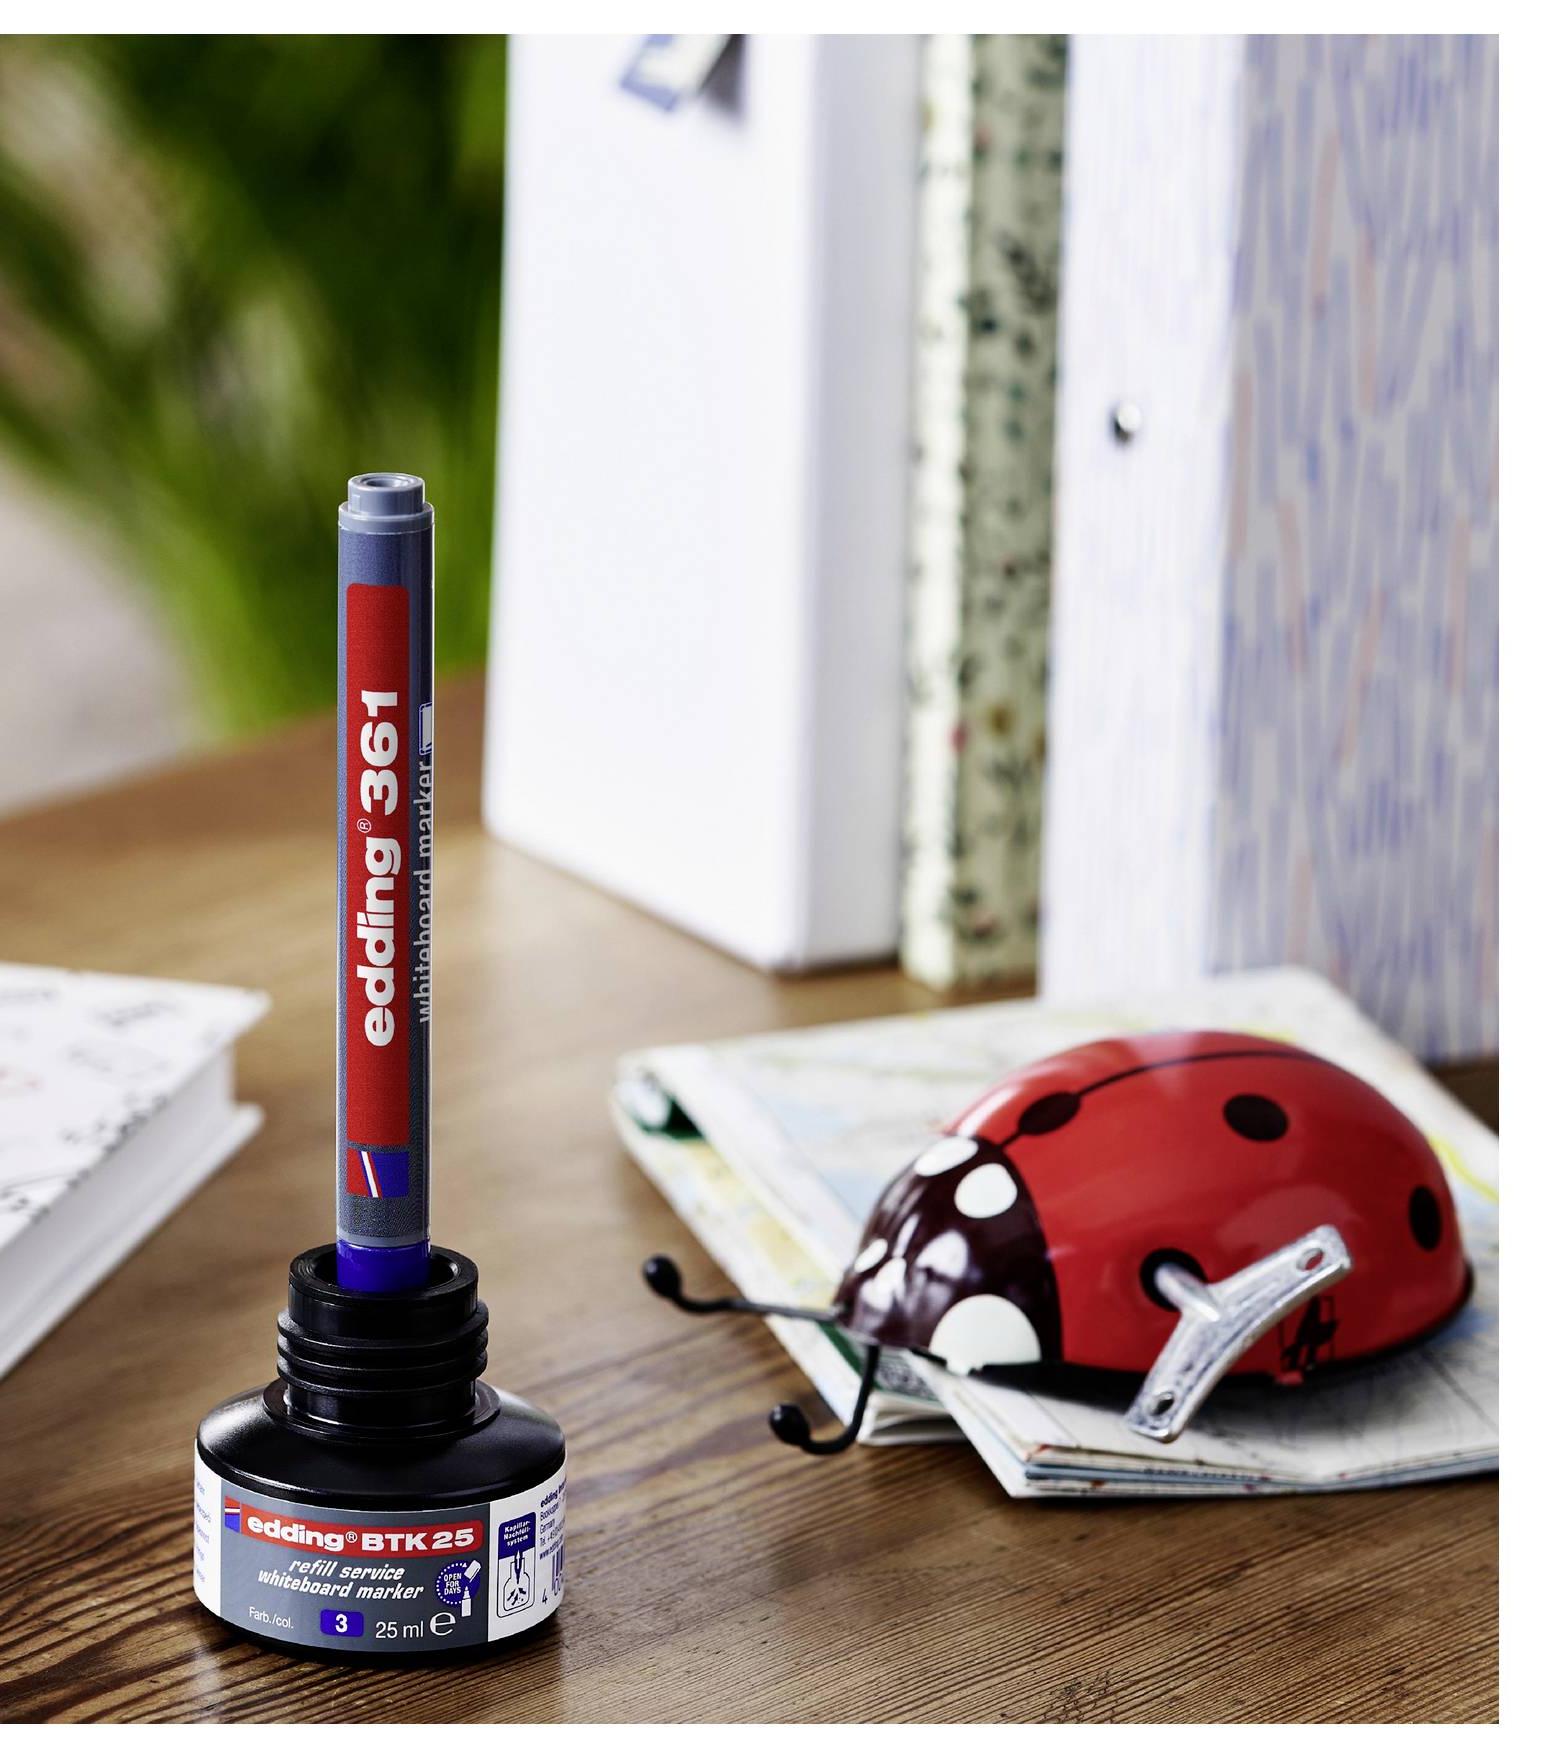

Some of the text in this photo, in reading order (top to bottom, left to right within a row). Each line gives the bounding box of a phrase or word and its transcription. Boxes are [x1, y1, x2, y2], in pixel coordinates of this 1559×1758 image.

[360, 689, 399, 816] 361
[413, 761, 433, 1023] whiteboard marker
[361, 1532, 428, 1552] BTK
[431, 1528, 475, 1550] 25
[506, 1534, 529, 1547] system
[288, 1559, 406, 1580] refill service
[443, 1572, 462, 1582] OPEN
[257, 1569, 424, 1600] whiteboard marker
[443, 1586, 462, 1596] DAYS
[445, 1580, 460, 1588] FOR
[541, 1588, 548, 1605] 4
[248, 1606, 294, 1630] Farb./col.
[335, 1613, 348, 1633] 3
[375, 1621, 398, 1639] 25
[402, 1620, 424, 1638] ml
